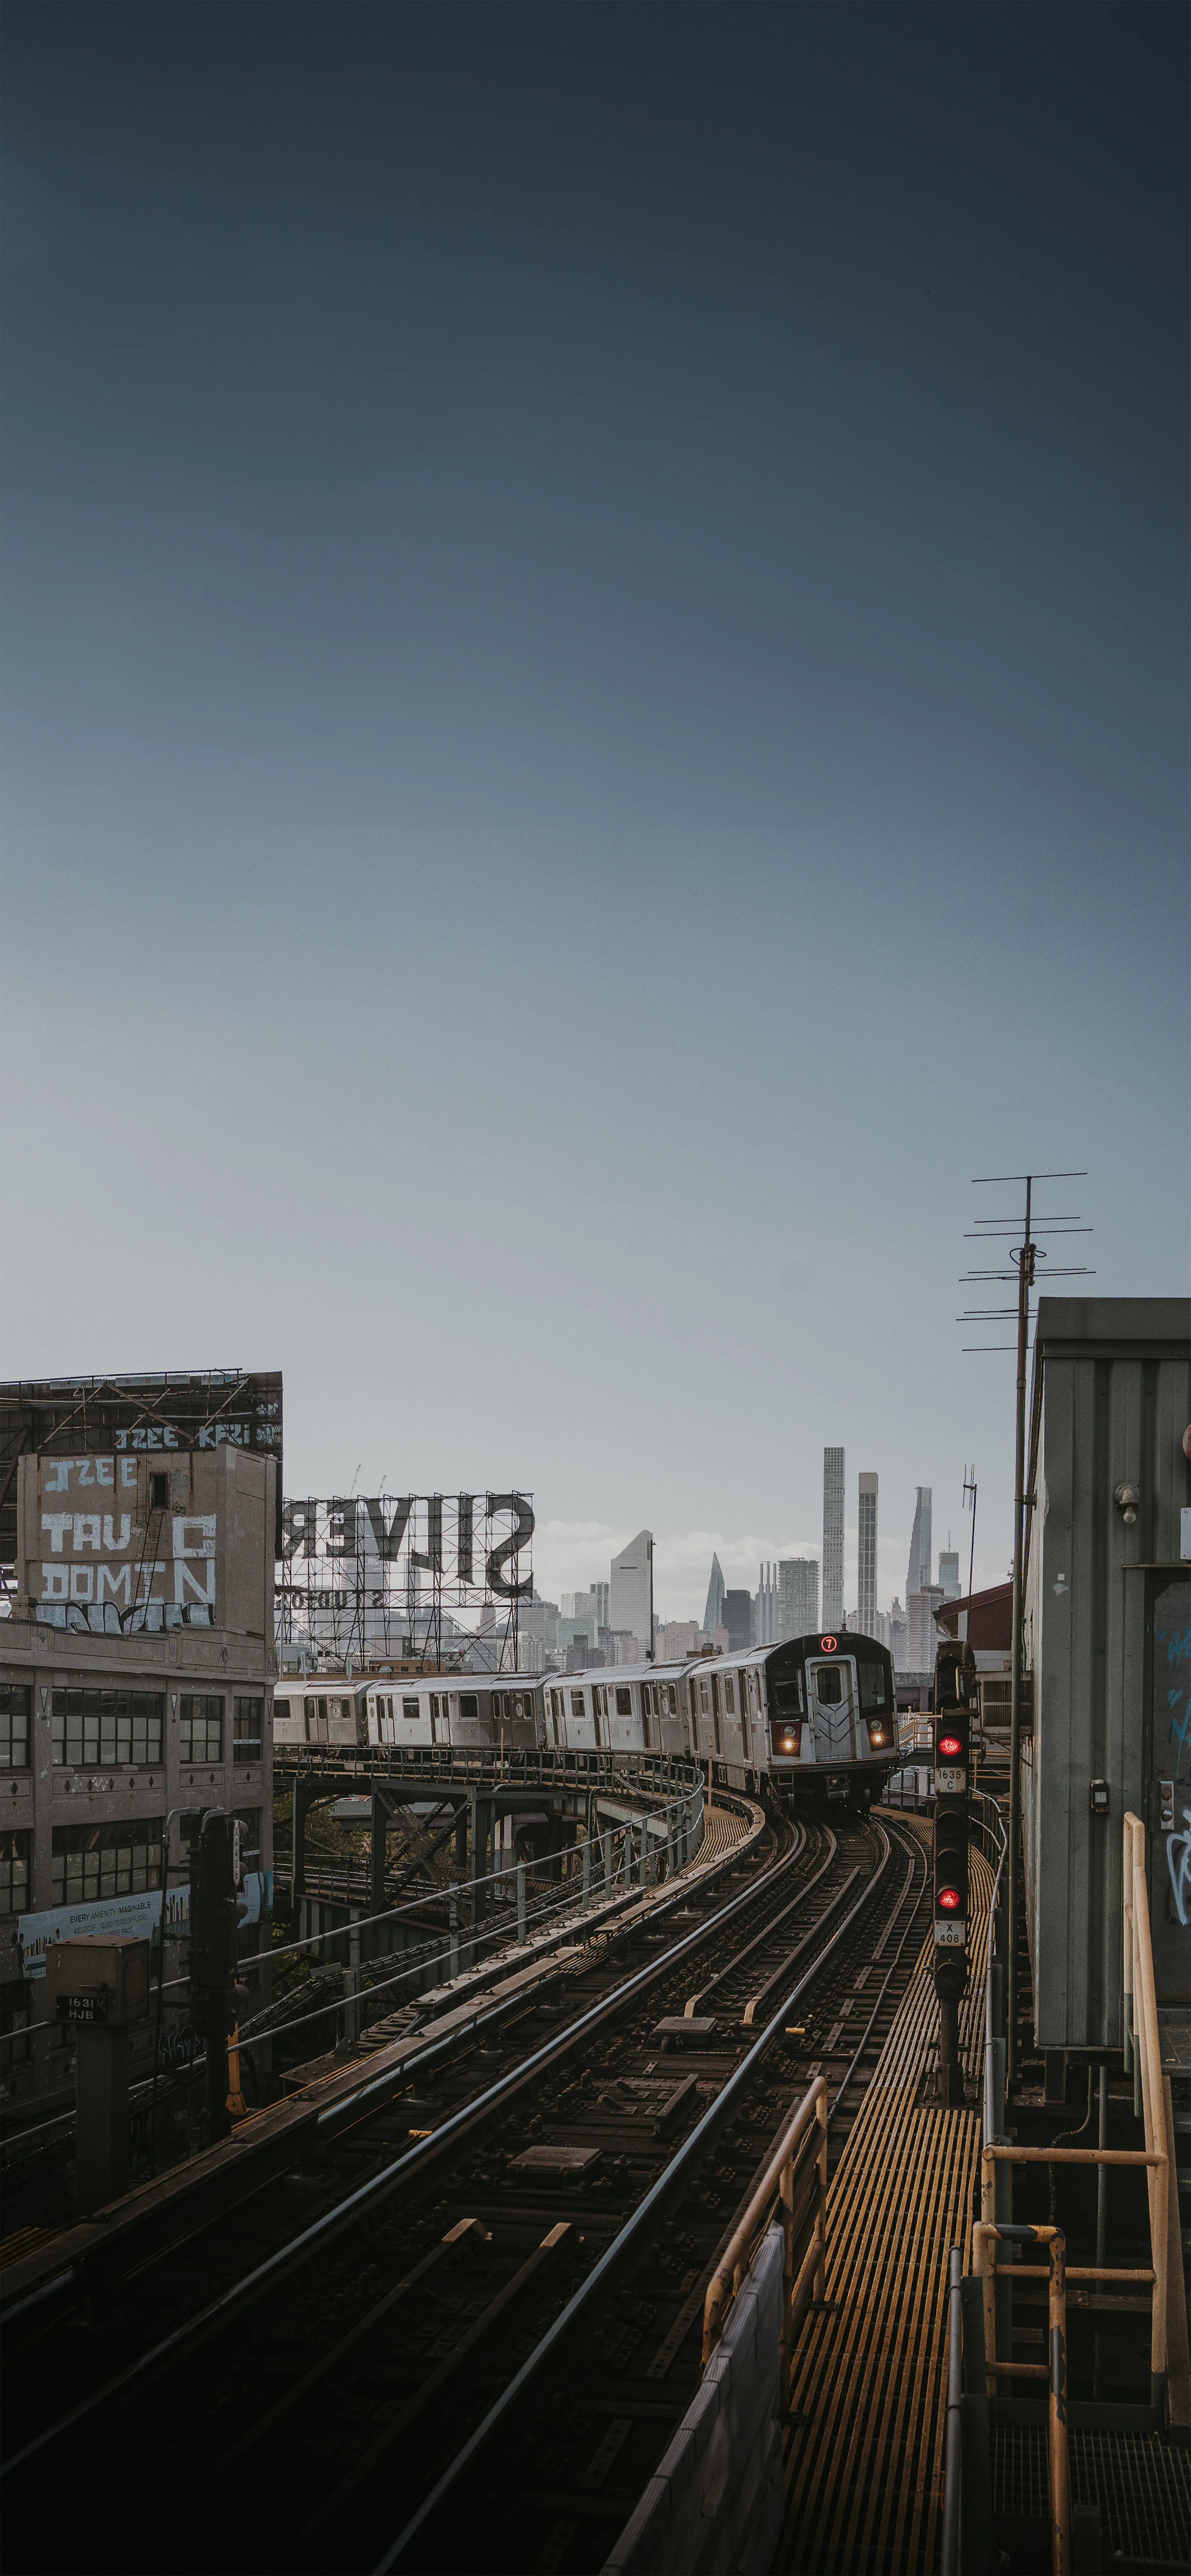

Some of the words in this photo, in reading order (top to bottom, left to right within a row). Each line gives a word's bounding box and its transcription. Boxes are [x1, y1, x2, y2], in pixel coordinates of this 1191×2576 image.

[940, 1771, 961, 1779] 1635
[947, 1781, 953, 1789] C
[70, 1913, 90, 1924] EVERY
[91, 1909, 117, 1919] AMENITY
[118, 1901, 151, 1915] IMAGINABLE
[133, 1913, 147, 1922] FLOORS
[121, 1927, 133, 1936] SPACE
[940, 1934, 959, 1943] 408
[69, 1998, 94, 2007] 1631
[69, 2010, 94, 2019] HJB
